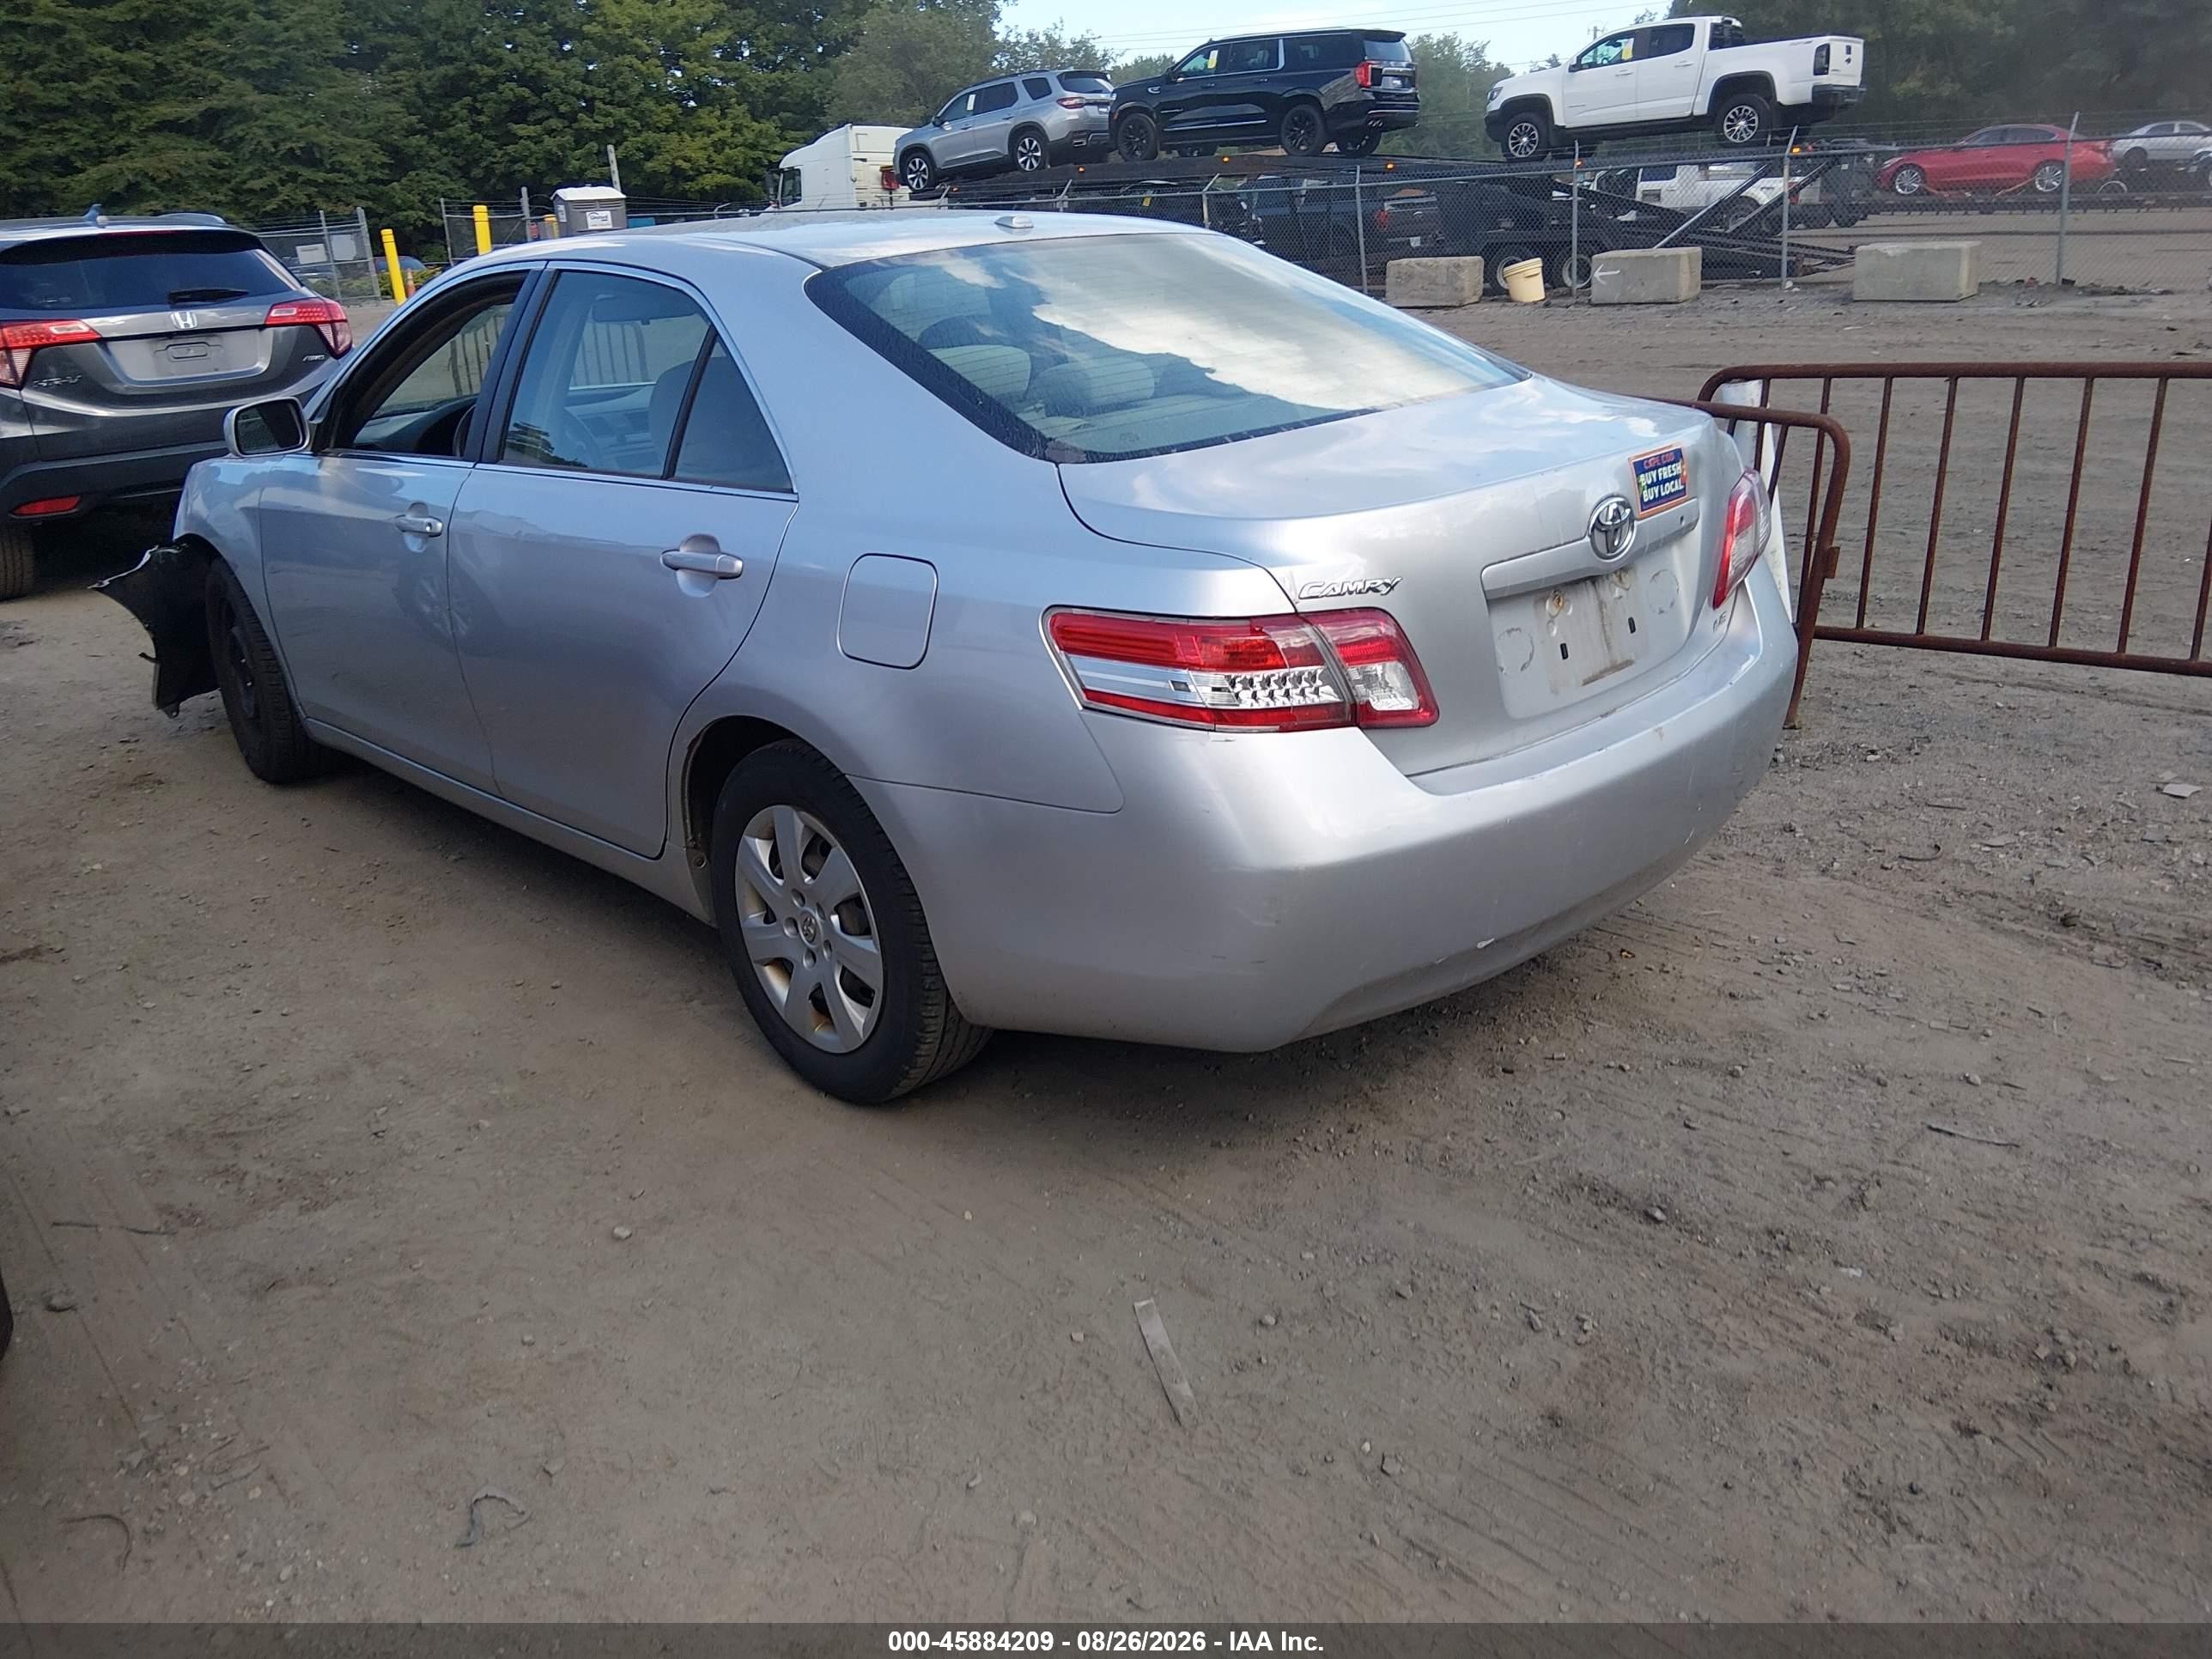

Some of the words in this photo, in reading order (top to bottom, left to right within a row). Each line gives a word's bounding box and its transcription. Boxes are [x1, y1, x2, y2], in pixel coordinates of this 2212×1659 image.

[1639, 470, 1657, 486] BUY
[1657, 460, 1682, 481] FRESH
[1642, 484, 1660, 502] BUY
[1660, 478, 1685, 496] LOCAL
[1297, 576, 1403, 600] CAMRY
